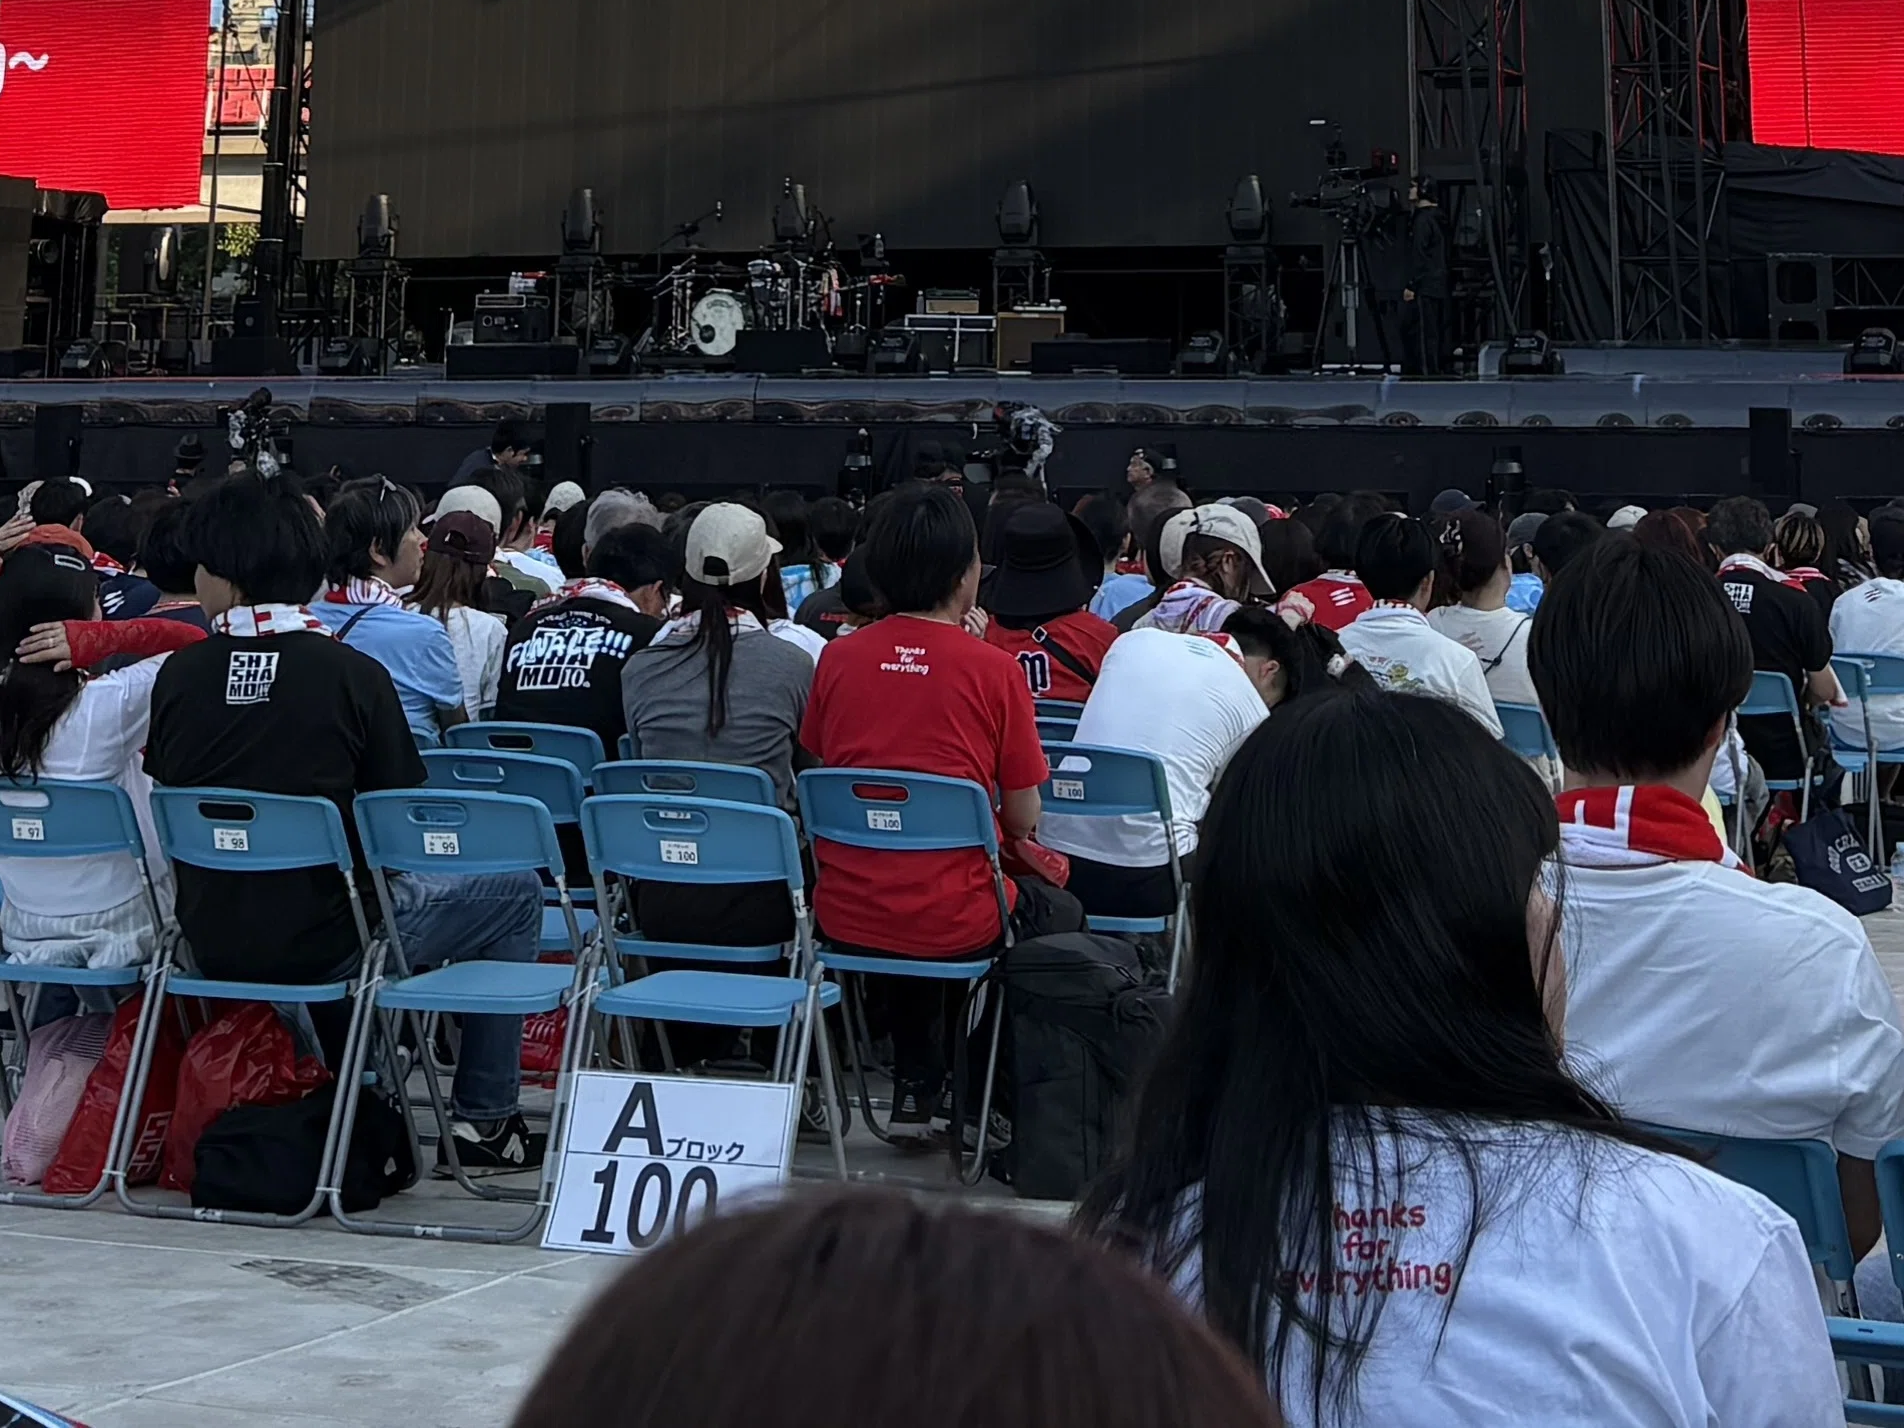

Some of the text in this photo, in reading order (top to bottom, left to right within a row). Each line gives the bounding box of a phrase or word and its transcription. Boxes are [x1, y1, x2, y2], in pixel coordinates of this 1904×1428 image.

[231, 837, 245, 849] 98
[441, 842, 456, 853] 99
[677, 851, 696, 862] 100
[580, 1160, 718, 1249] 100
[1330, 1202, 1427, 1231] hanks
[1342, 1231, 1392, 1262] for
